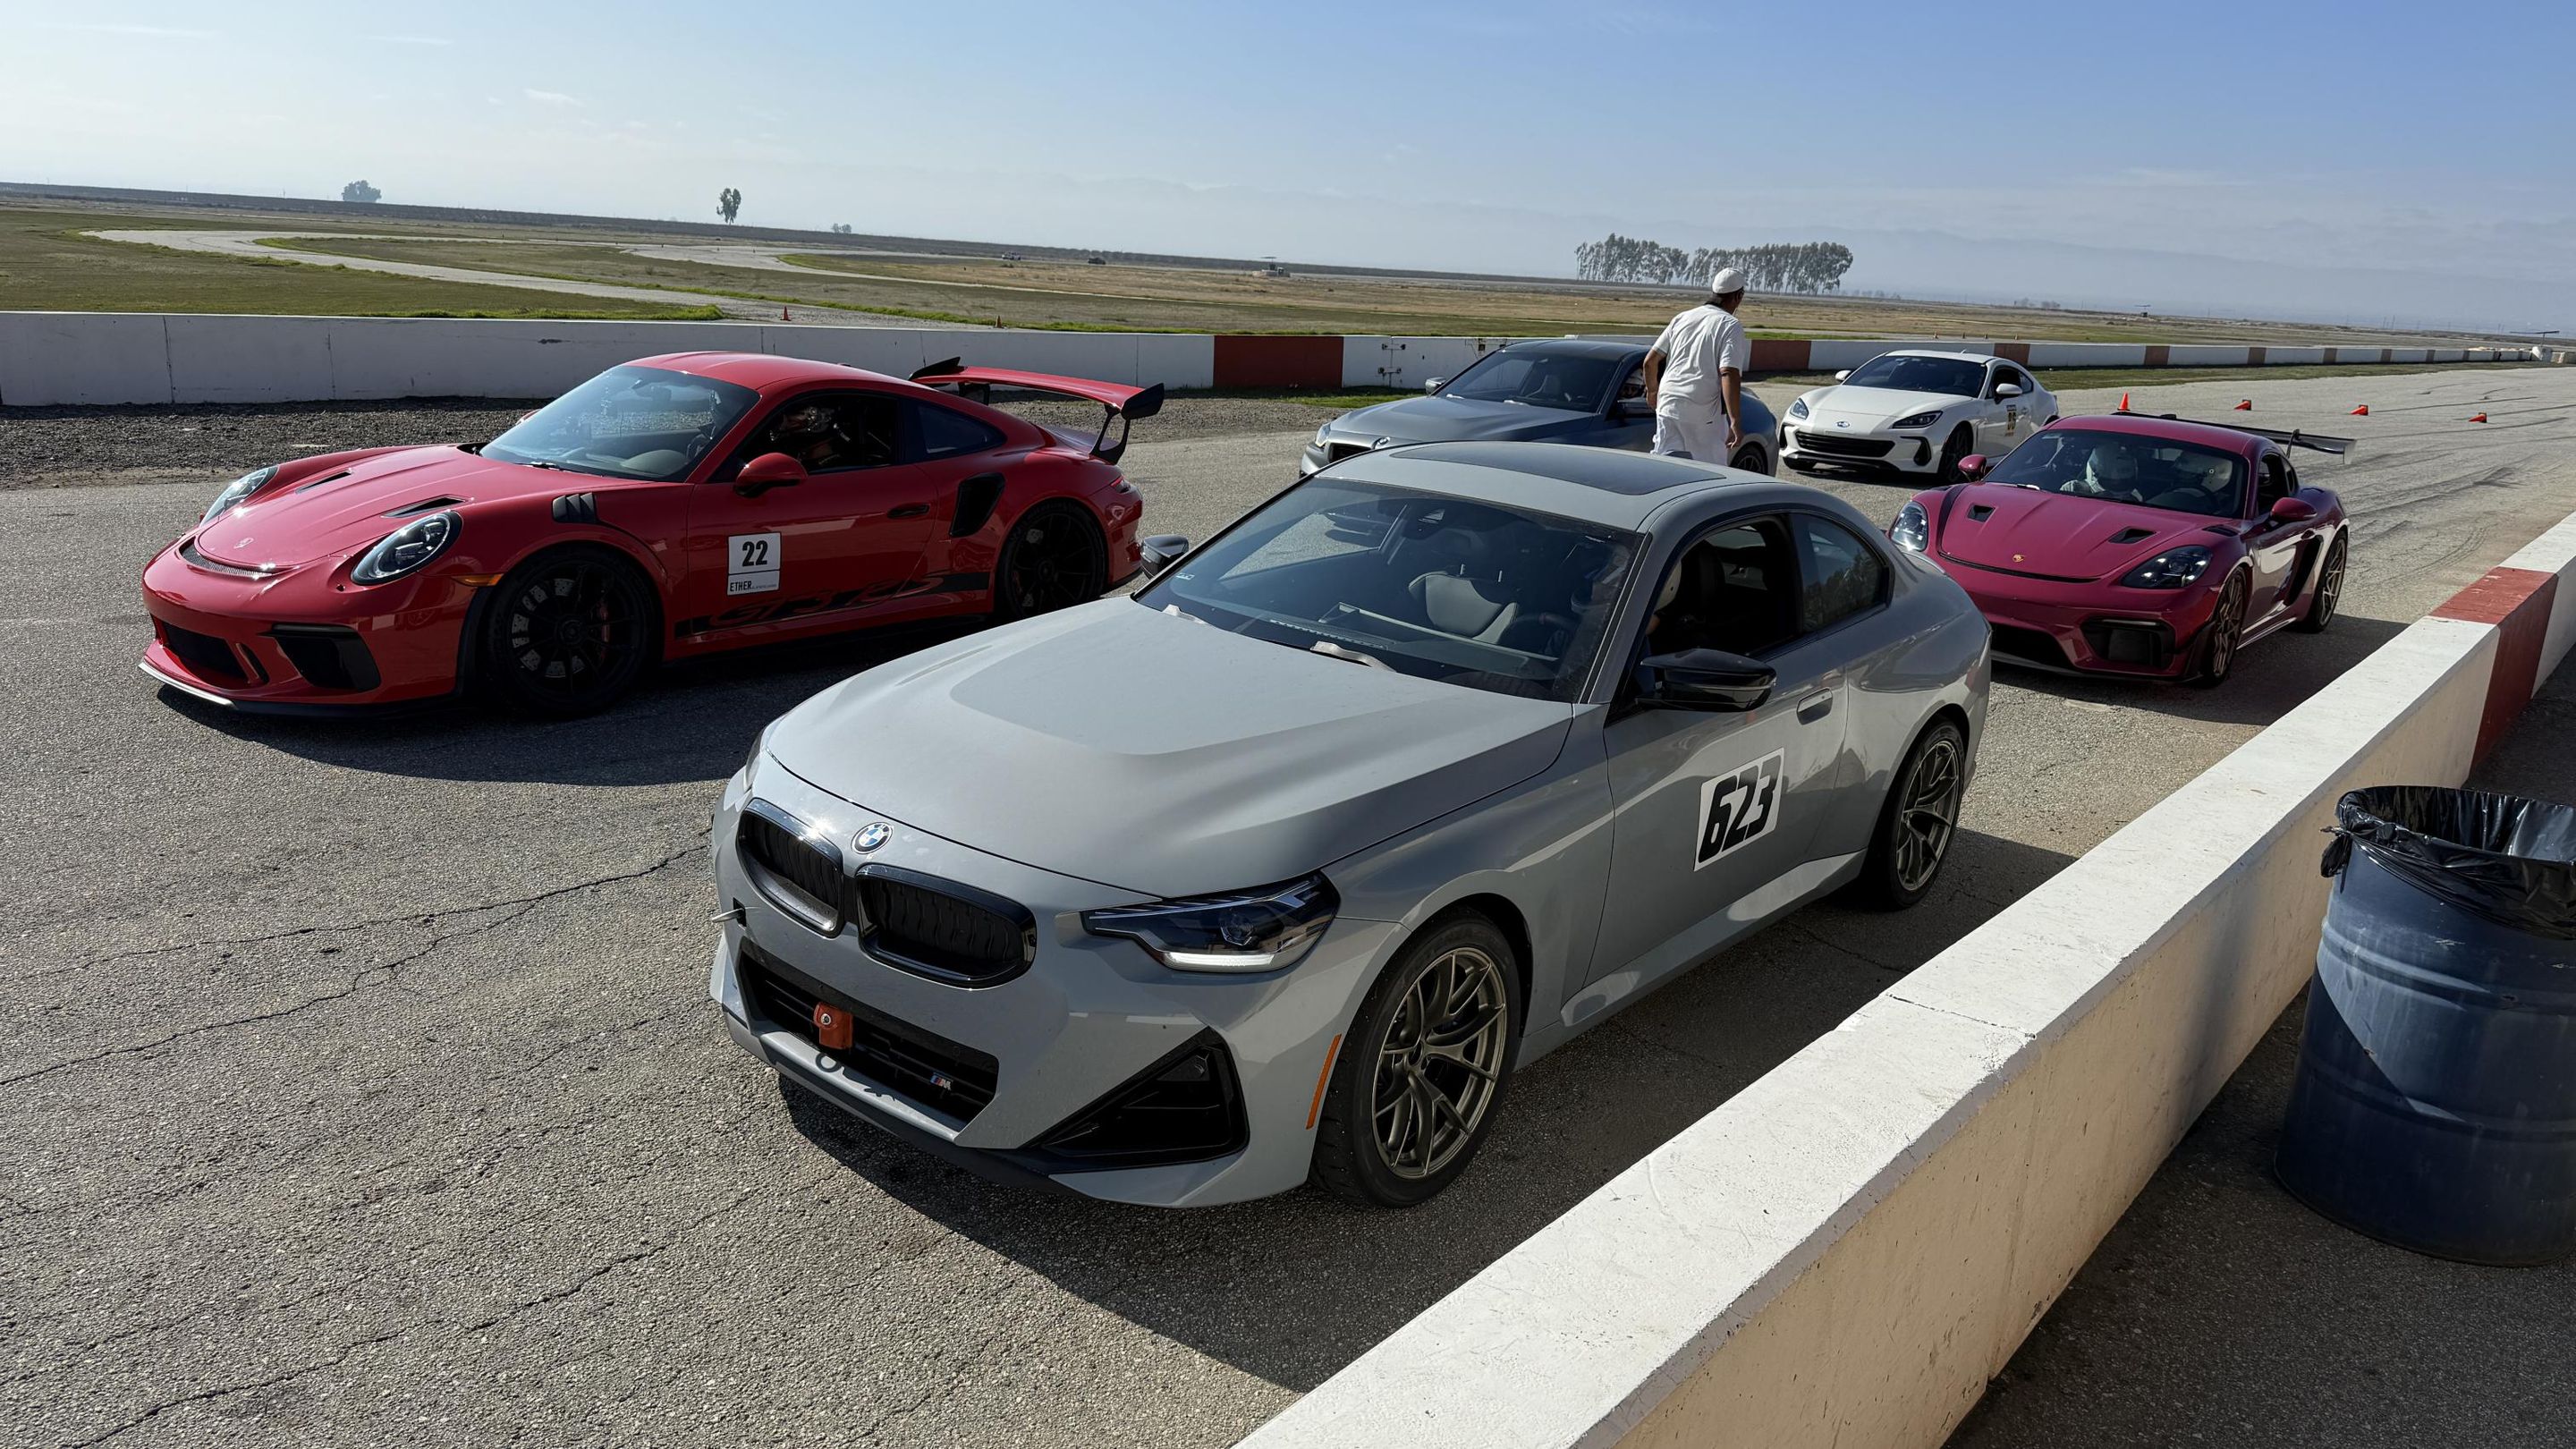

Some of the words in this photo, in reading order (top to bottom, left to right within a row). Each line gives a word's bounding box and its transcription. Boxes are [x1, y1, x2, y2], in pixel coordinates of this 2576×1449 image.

[741, 539, 768, 567] 22
[730, 580, 752, 592] ETHER
[1699, 754, 1782, 864] 623
